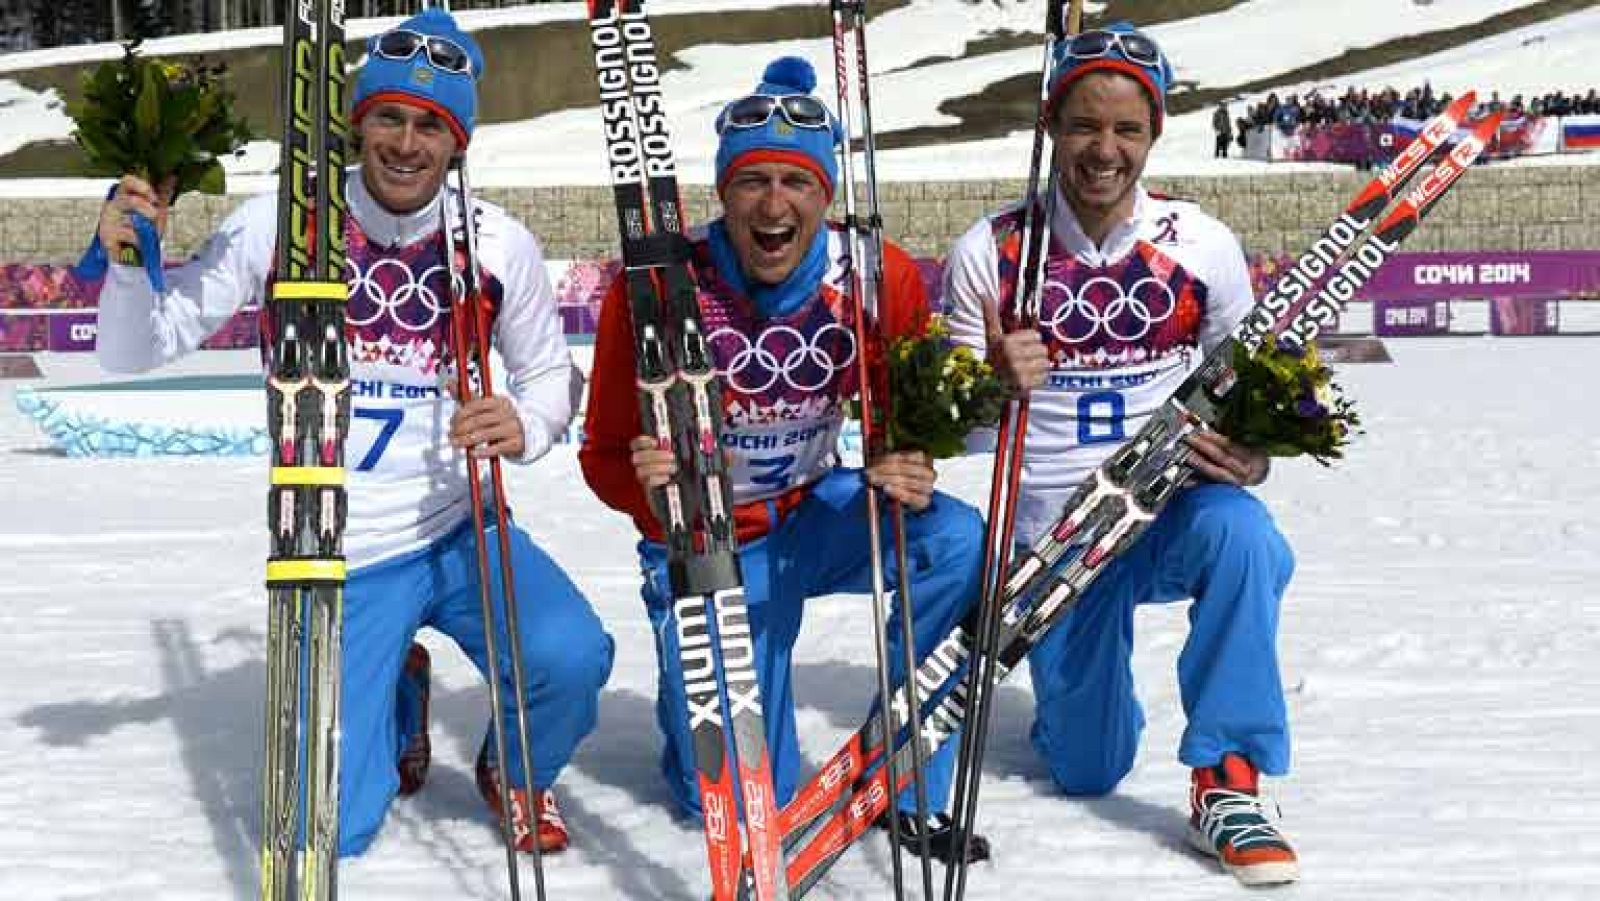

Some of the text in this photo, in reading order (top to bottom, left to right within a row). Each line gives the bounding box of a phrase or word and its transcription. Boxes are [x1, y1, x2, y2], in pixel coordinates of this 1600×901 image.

[590, 8, 641, 184] ROSSIGNOL
[621, 3, 675, 177] ROSSIGNOL
[1379, 138, 1427, 186] WCS
[1405, 163, 1454, 206] WCS
[1479, 263, 1530, 284] 2014
[350, 379, 383, 398] CHI
[354, 408, 404, 471] 7
[721, 433, 777, 449] OCHI
[1077, 391, 1125, 444] 8
